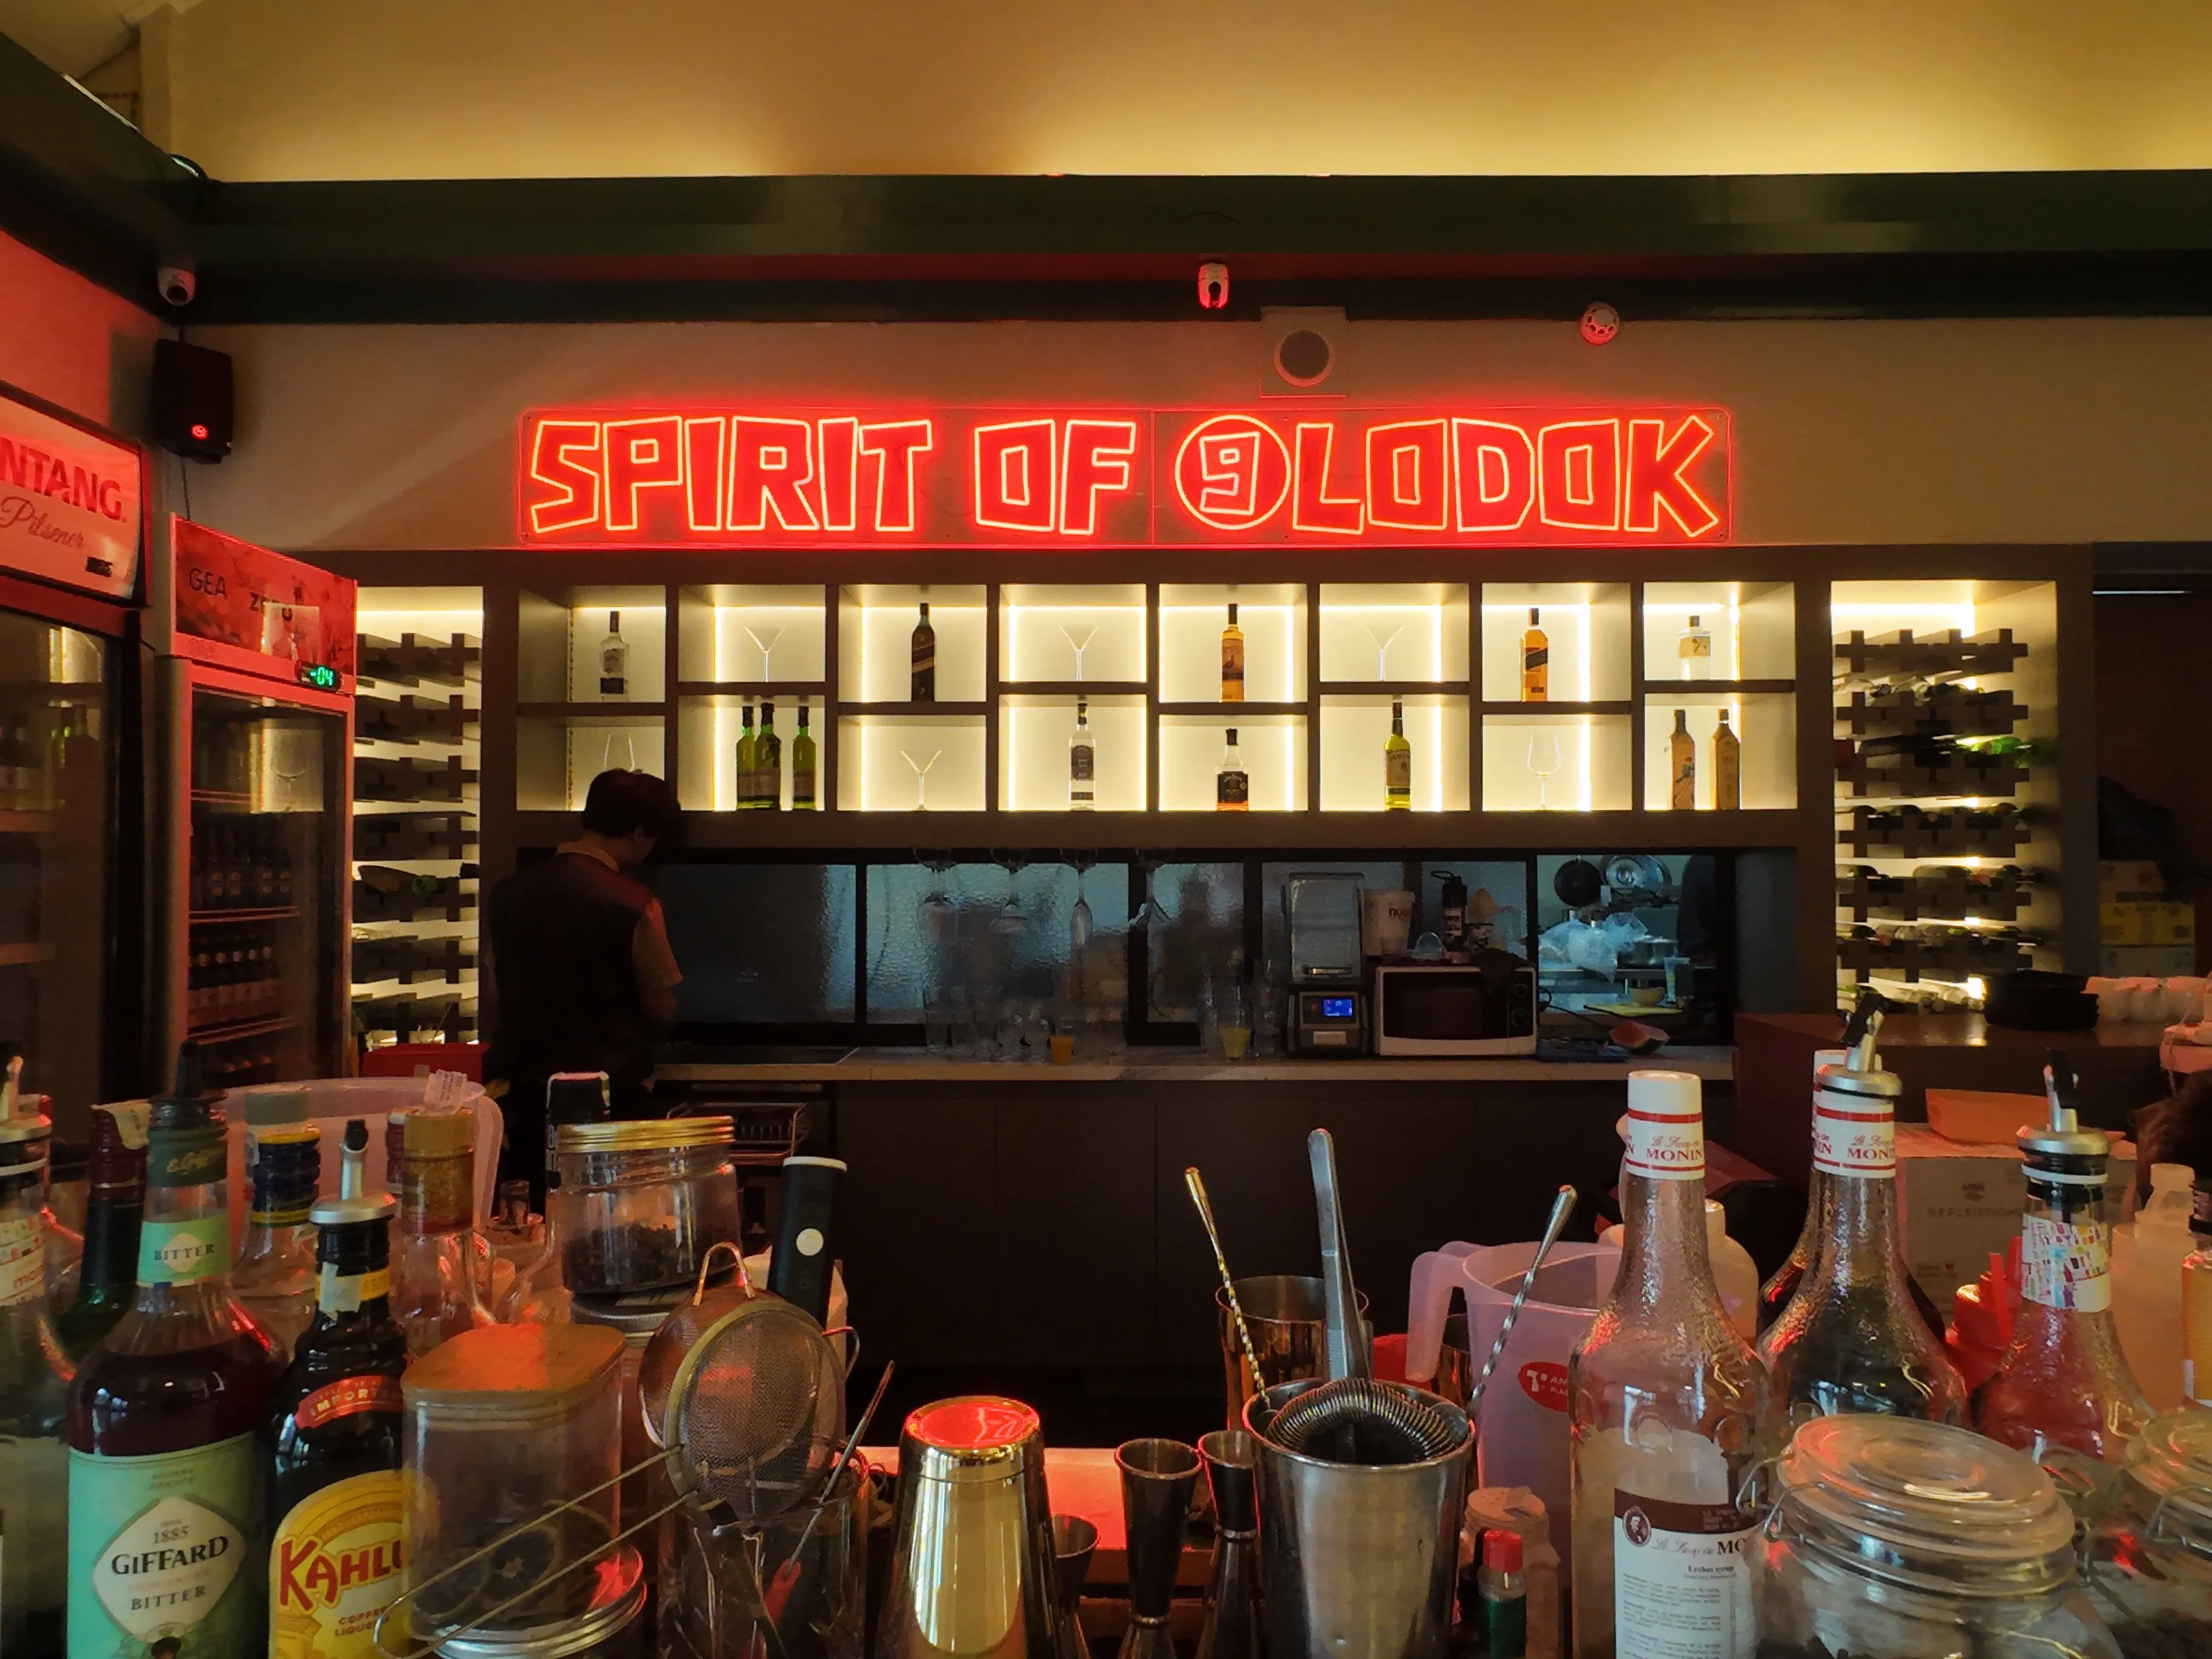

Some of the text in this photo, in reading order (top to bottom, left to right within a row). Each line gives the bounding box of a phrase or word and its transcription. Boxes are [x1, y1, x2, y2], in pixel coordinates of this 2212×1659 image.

[530, 416, 933, 534] SPIRIT
[974, 419, 1136, 535] OF
[189, 568, 228, 600] GEA
[1646, 1148, 1703, 1161] MONIN
[154, 1244, 215, 1261] BITTER
[153, 1526, 189, 1544] 1885
[110, 1535, 229, 1576] GIFFARD
[130, 1584, 206, 1611] BITTER
